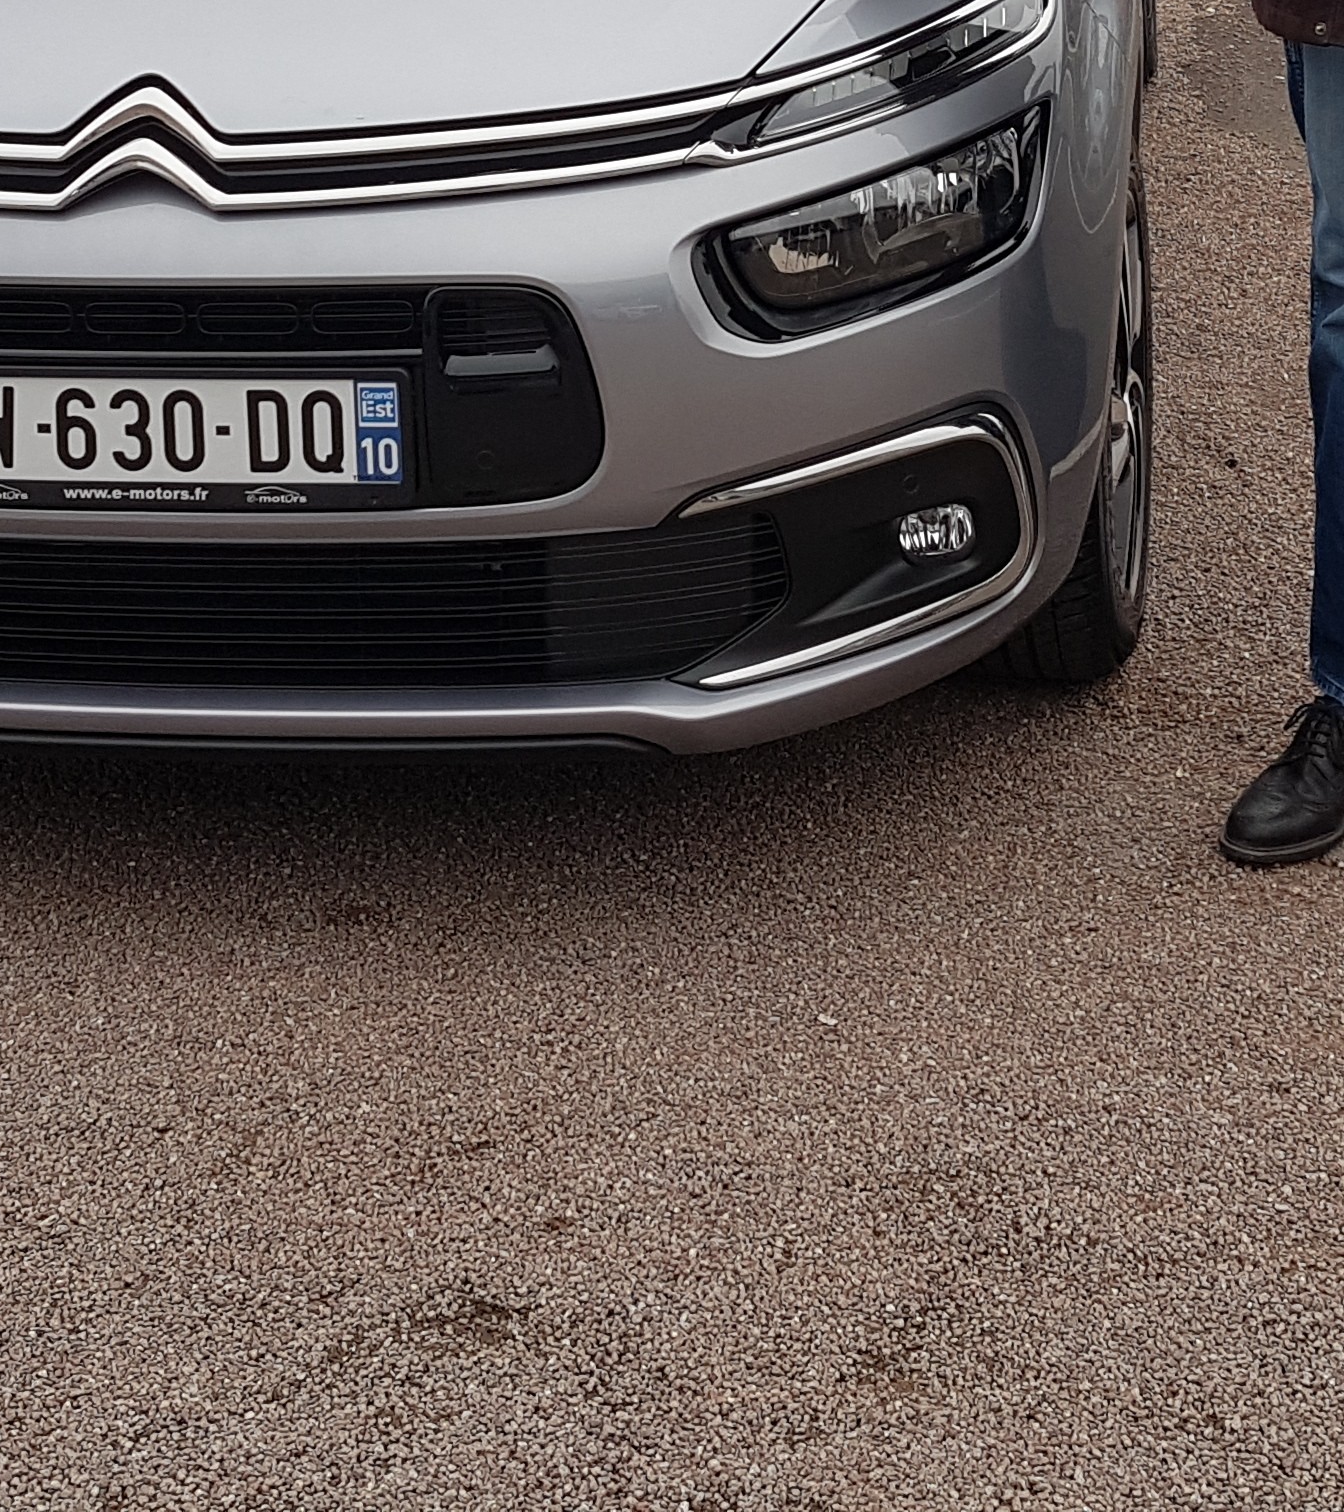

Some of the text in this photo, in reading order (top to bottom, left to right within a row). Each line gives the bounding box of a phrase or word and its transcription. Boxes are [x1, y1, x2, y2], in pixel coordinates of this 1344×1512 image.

[361, 390, 394, 401] Grand
[361, 400, 394, 418] Est
[360, 437, 399, 476] 10
[63, 486, 209, 501] www.e-motors.fr
